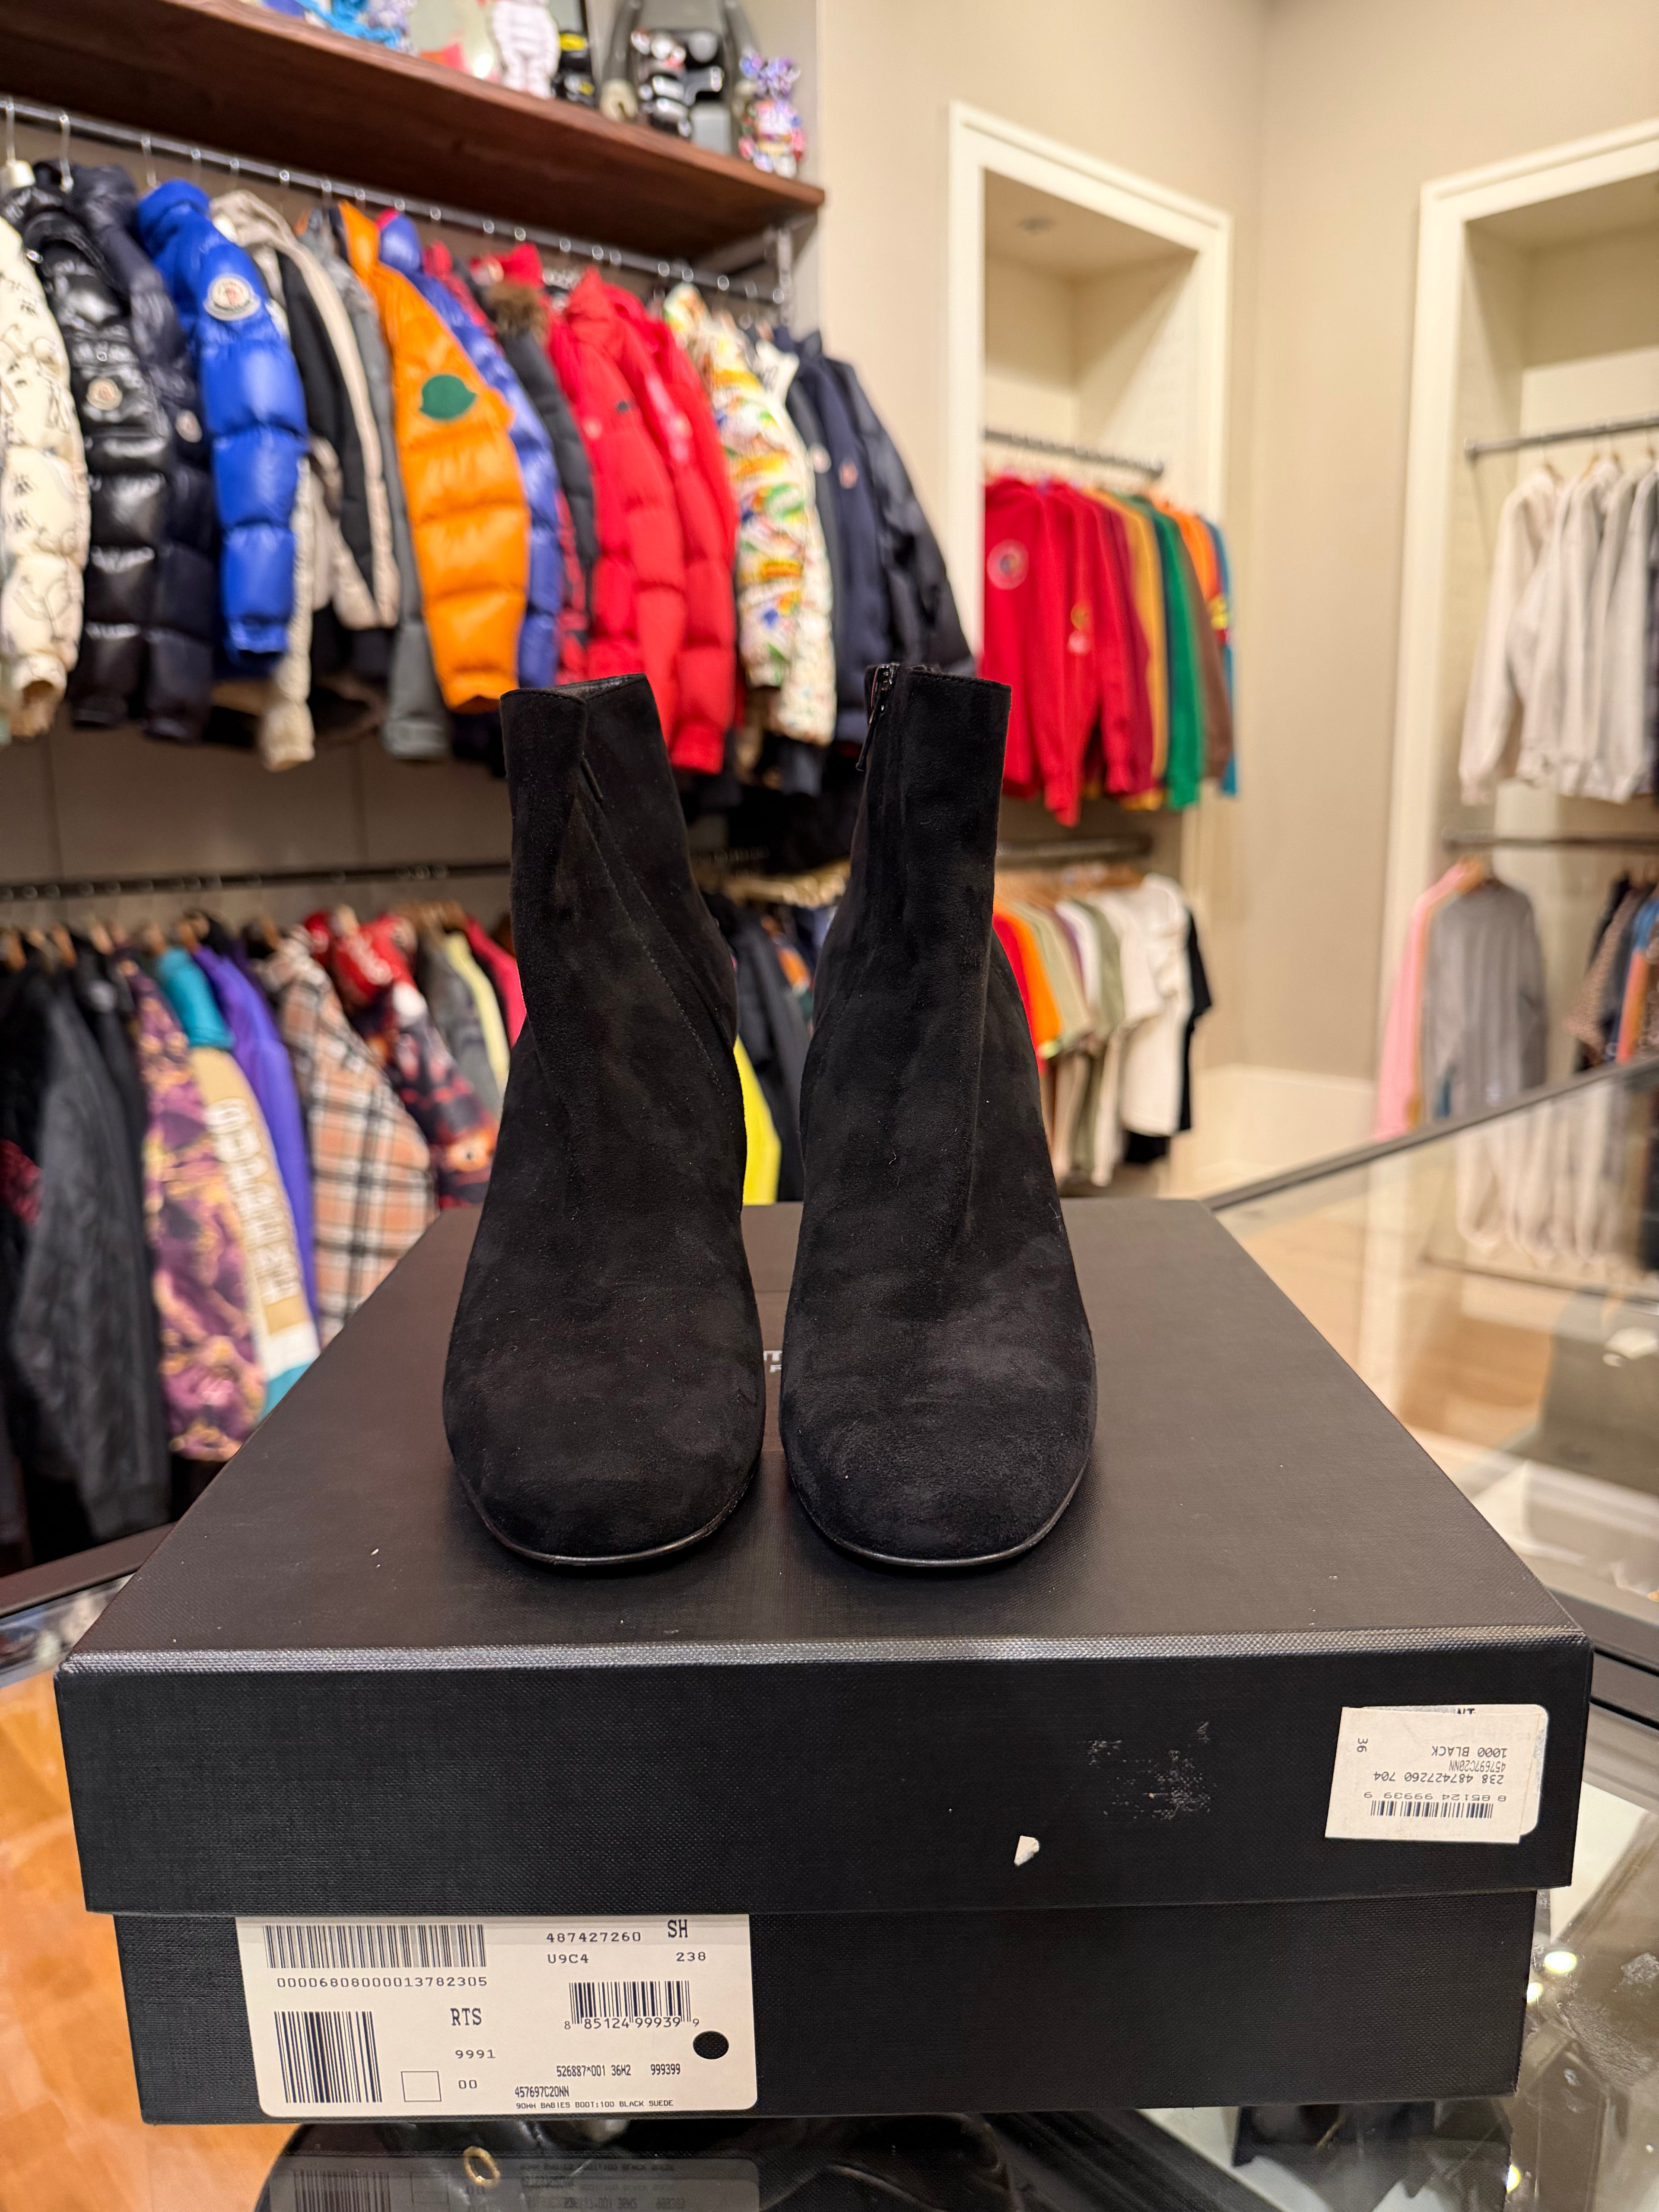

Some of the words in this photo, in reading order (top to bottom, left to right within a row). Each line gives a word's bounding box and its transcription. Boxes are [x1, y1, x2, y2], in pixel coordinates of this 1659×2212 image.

[1431, 1745, 1470, 1757] BLACK
[1477, 1747, 1508, 1758] 1000
[1373, 1771, 1395, 1782] 704
[1404, 1772, 1474, 1783] 487427260
[1481, 1774, 1504, 1785] 238
[546, 1932, 641, 1943] 487427260
[667, 1919, 688, 1938] SH
[547, 1954, 589, 1964] U9C4
[676, 1951, 706, 1962] 238
[277, 1977, 487, 1988] 00006808000013782305
[450, 2007, 482, 2026] RTS
[564, 2021, 571, 2030] 8
[584, 2018, 629, 2029] 85124
[635, 2017, 680, 2028] 99939
[693, 2018, 699, 2027] 9
[455, 2049, 496, 2059] 9991
[650, 2063, 680, 2075] 999399
[458, 2079, 477, 2089] 00
